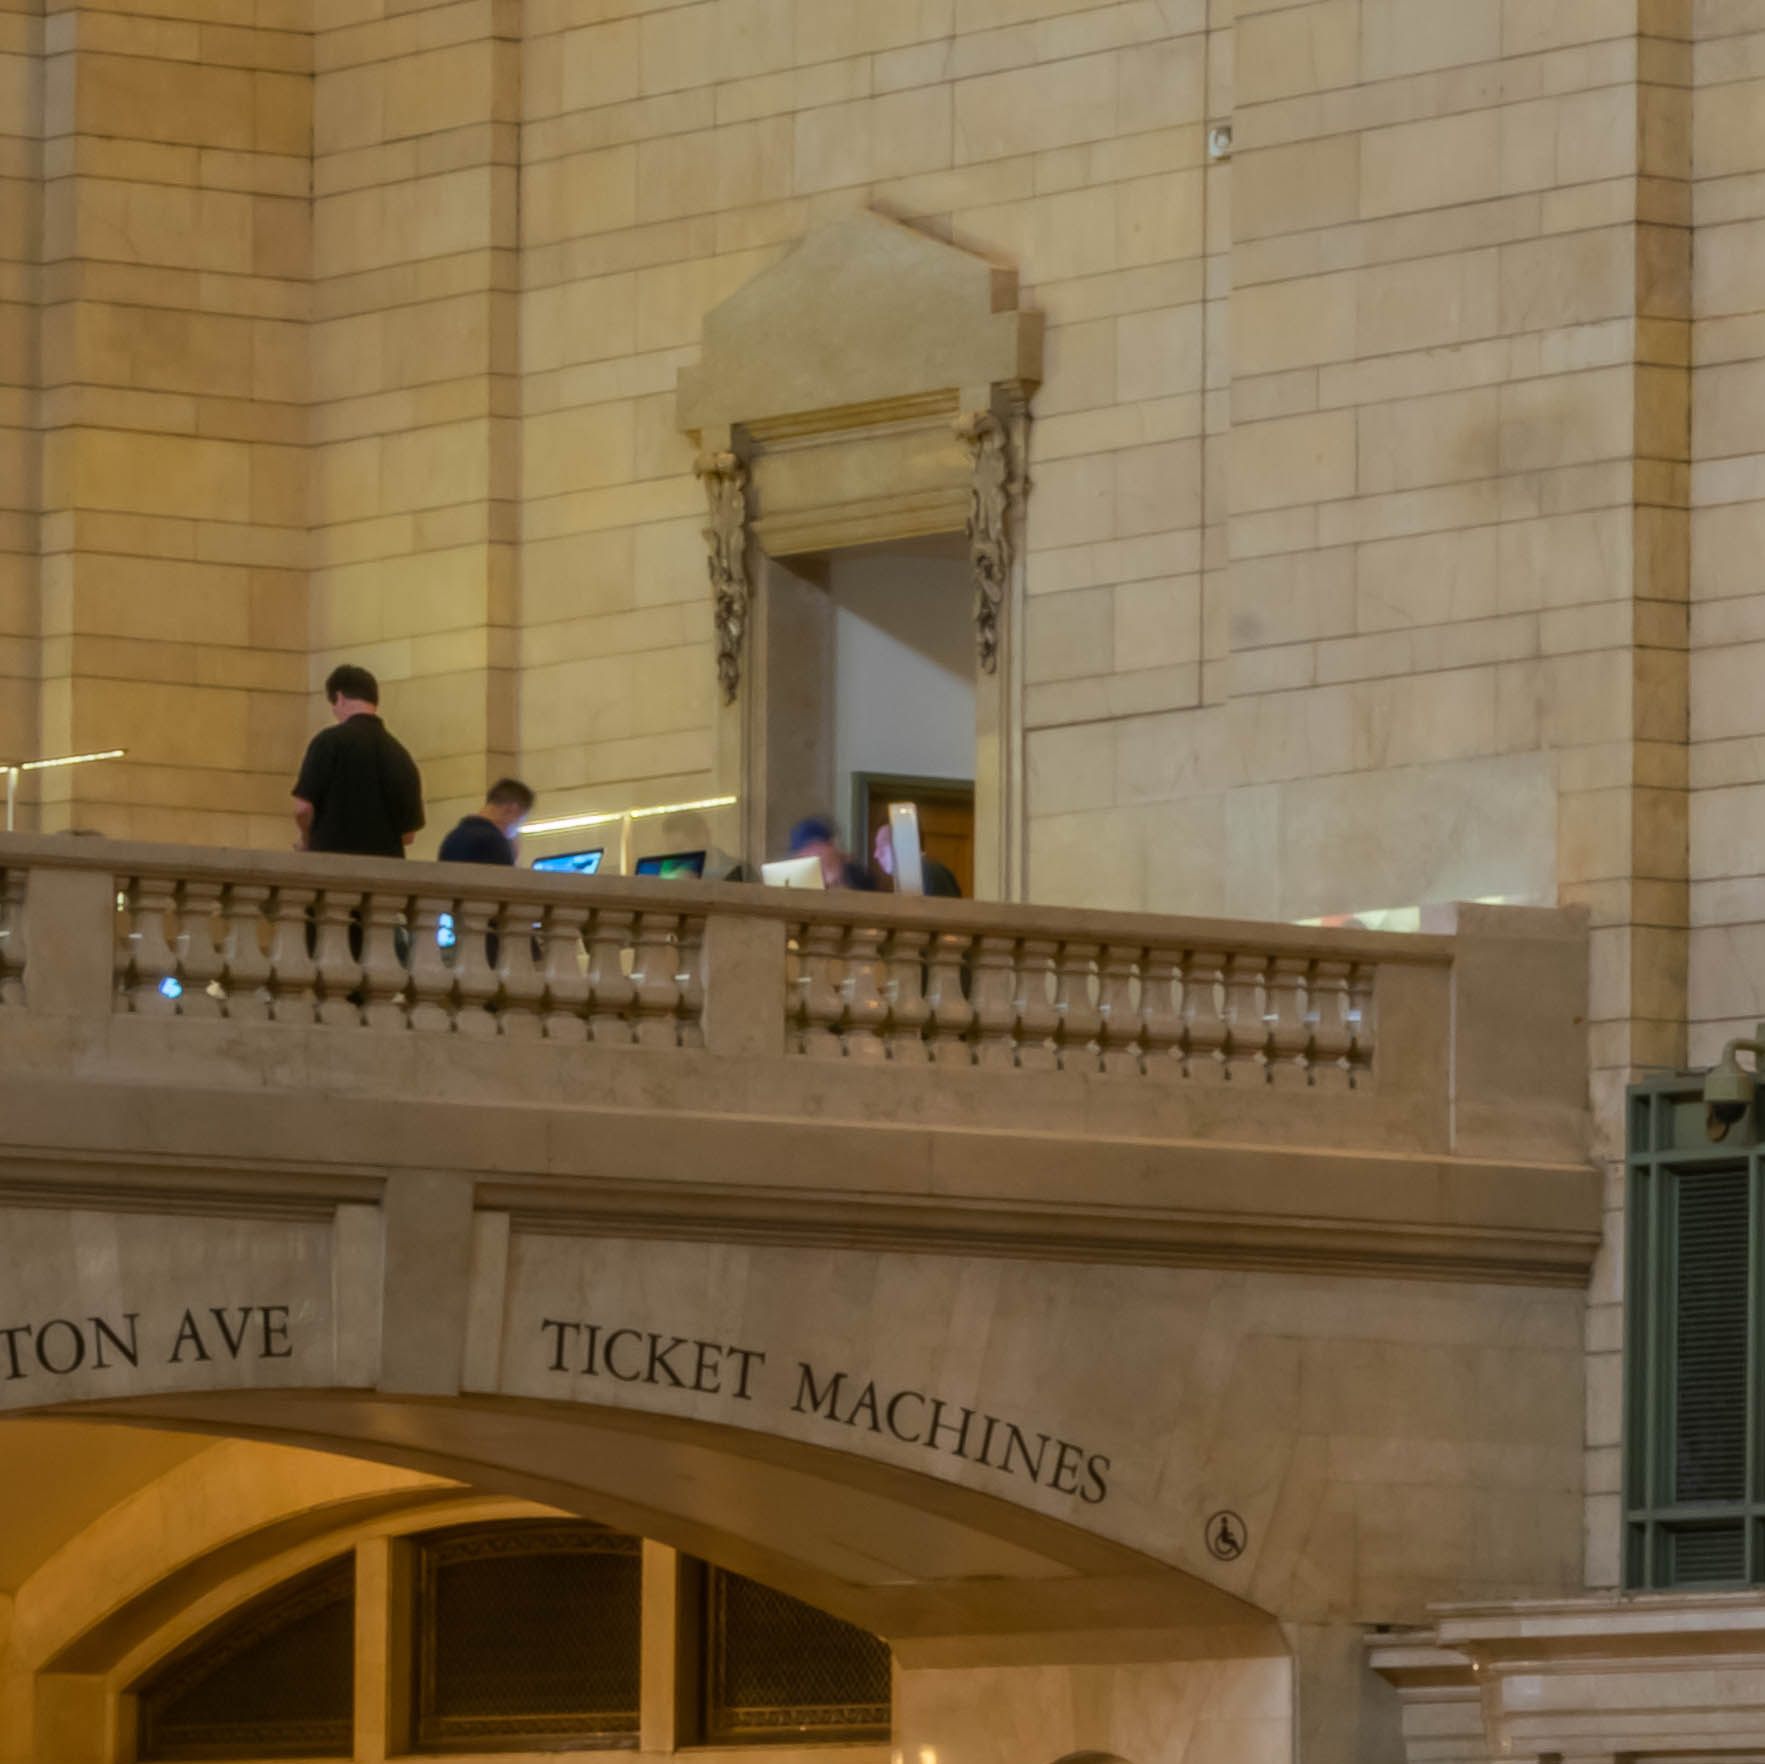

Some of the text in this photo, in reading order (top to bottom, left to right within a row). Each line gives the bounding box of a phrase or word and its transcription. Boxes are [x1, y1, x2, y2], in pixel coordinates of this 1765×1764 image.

[168, 1305, 292, 1363] AVE
[541, 1318, 1113, 1504] TICKET MACHINES
